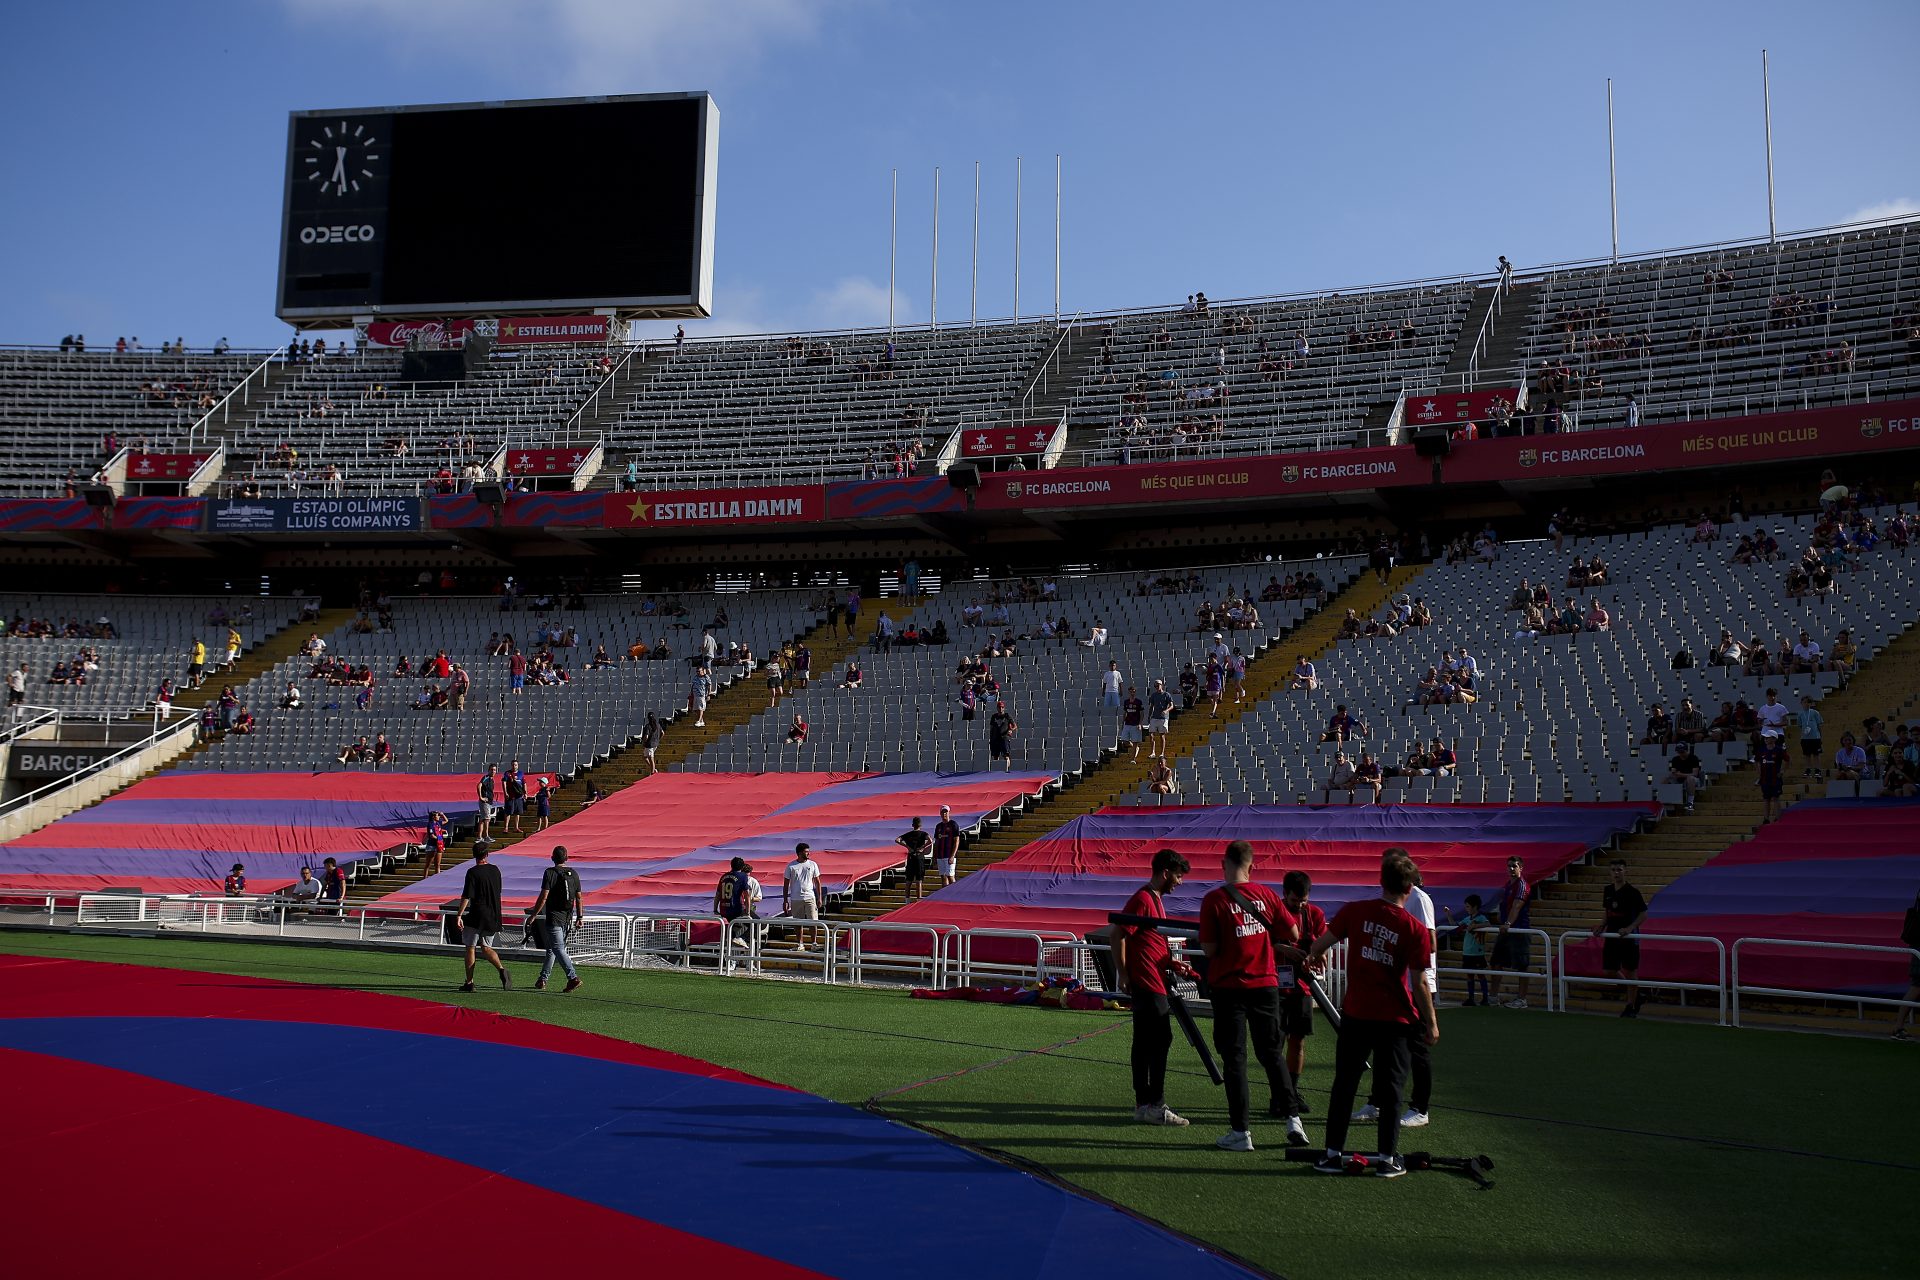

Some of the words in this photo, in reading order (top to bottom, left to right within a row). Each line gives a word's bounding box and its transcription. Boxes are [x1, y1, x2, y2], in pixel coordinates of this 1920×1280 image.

[300, 224, 375, 244] ODECO
[518, 325, 567, 336] ESTRELLA
[570, 324, 603, 335] DAMM
[1888, 418, 1908, 433] FC
[1682, 434, 1714, 453] MÉS
[1717, 433, 1749, 452] QUE
[1752, 431, 1774, 446] UN
[1778, 427, 1818, 444] CLUB
[1541, 450, 1559, 464] FC
[1561, 444, 1645, 462] BARCELONA
[1303, 467, 1318, 479] FC
[1321, 461, 1397, 478] BARCELONA
[1026, 483, 1039, 495] FC
[1042, 480, 1111, 495] BARCELONA
[1140, 475, 1167, 490] MÉS
[1169, 474, 1194, 490] QUE
[1197, 473, 1215, 487] UN
[1217, 472, 1249, 486] CLUB
[292, 501, 343, 514] ESTADI
[347, 498, 406, 513] OLÍMPIC
[654, 501, 741, 521] ESTRELLA
[744, 498, 802, 517] DAMM
[286, 514, 327, 528] LLUÍS
[332, 513, 411, 528] COMPANYS
[721, 882, 734, 900] 19
[1363, 920, 1374, 934] LA
[1374, 924, 1399, 945] FESTA
[1372, 936, 1385, 951] DEL
